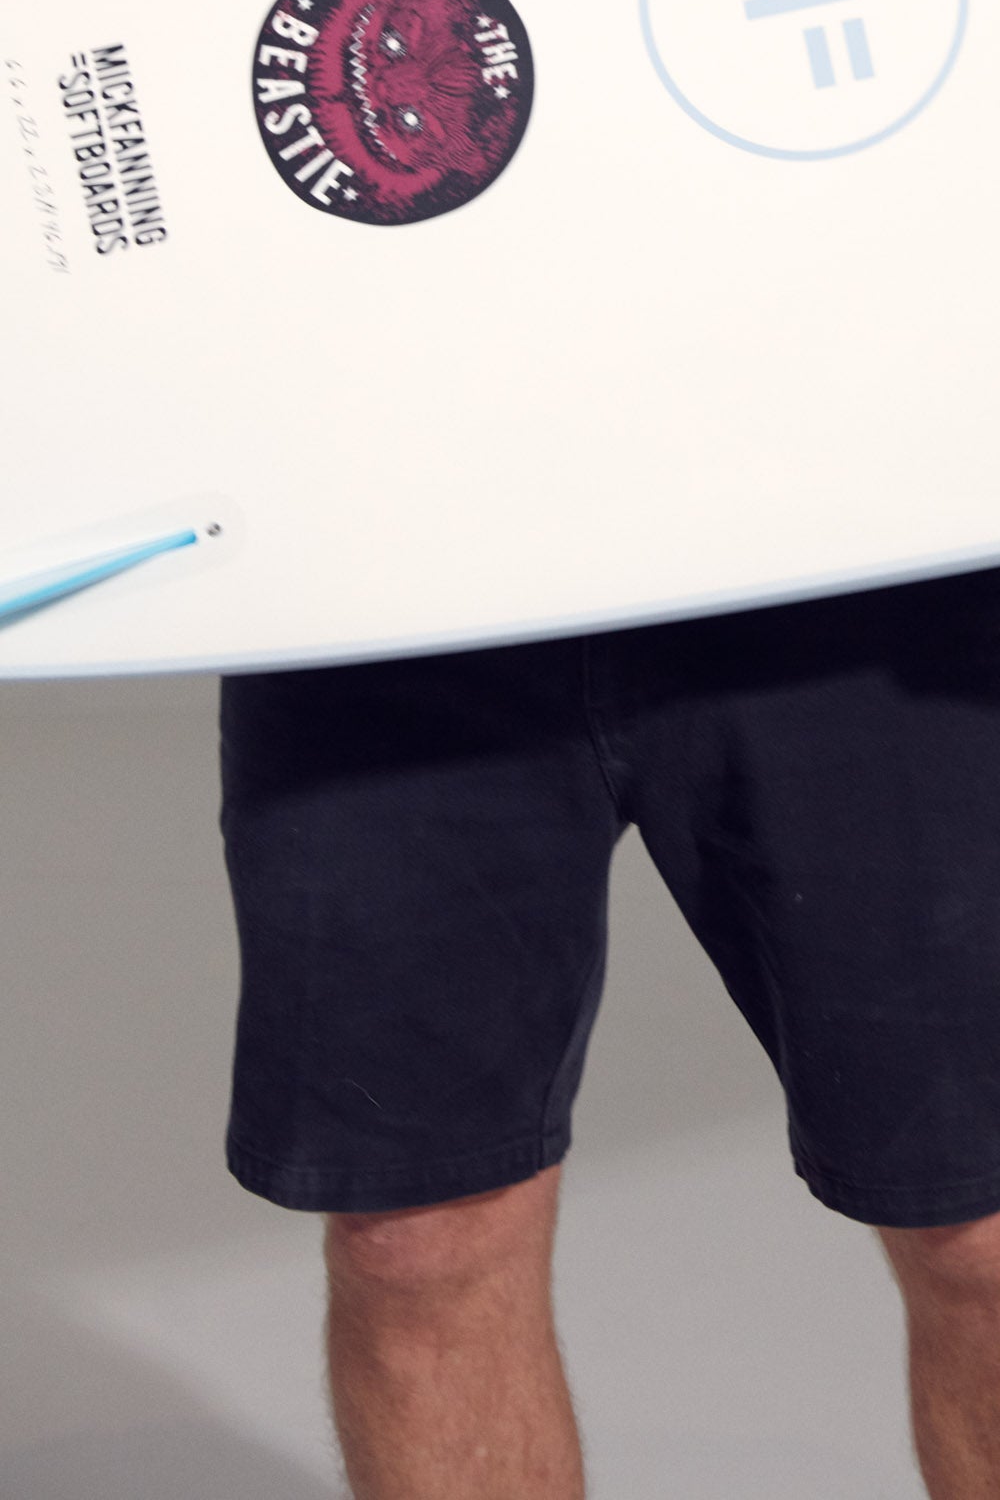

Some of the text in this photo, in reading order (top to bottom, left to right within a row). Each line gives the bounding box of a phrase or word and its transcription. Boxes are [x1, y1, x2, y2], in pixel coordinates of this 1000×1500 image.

[91, 45, 167, 245] MICKFANNING
[257, 10, 354, 206] BEASTIE
[474, 23, 518, 86] THE
